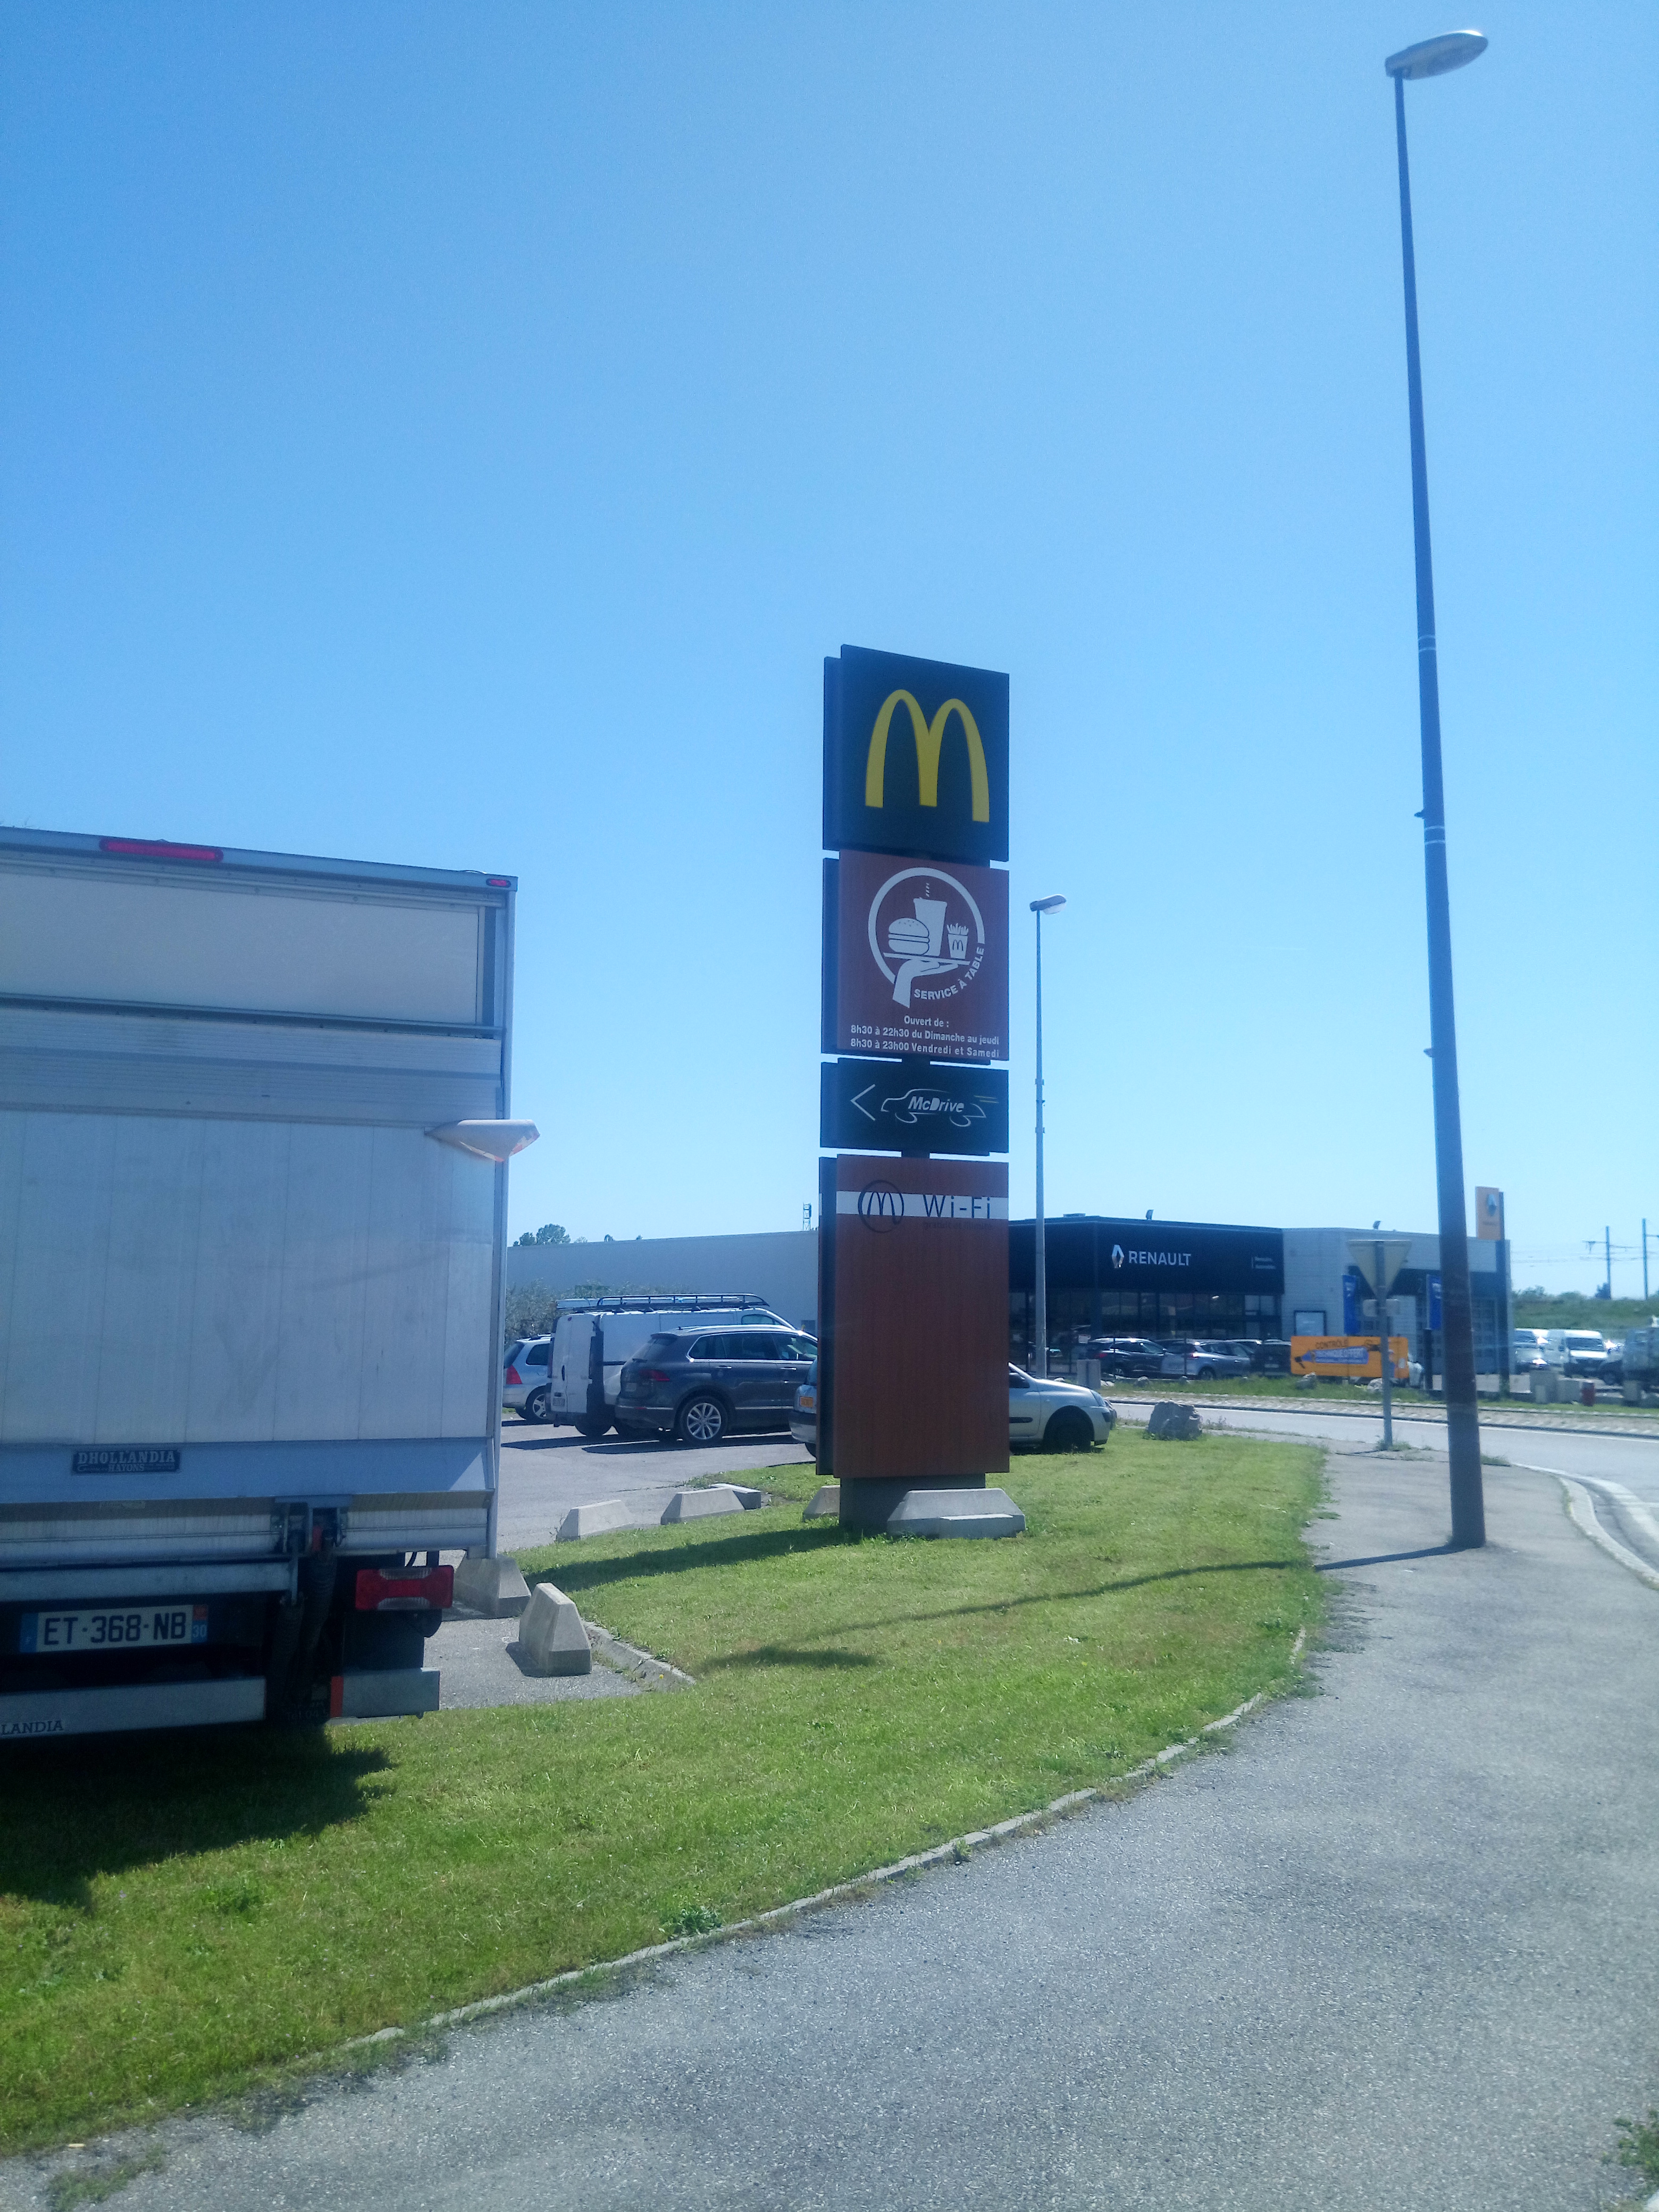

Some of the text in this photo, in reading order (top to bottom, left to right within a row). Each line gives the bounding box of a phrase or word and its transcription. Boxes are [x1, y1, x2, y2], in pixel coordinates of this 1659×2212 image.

[914, 946, 985, 1000] SERVICE À TABLE
[904, 1015, 932, 1026] Ouvert
[934, 1018, 944, 1027] de
[851, 1025, 873, 1034] 8h30
[875, 1026, 881, 1035] à
[883, 1027, 909, 1037] 22h30
[912, 1029, 923, 1038] du
[925, 1030, 965, 1042] Dimanche
[979, 1035, 999, 1045] jeudi
[850, 1038, 999, 1058] 8h30 à 23h00 Vendredi et Samedi
[908, 1096, 965, 1113] McDrive
[923, 1194, 991, 1219] Wi-Fi
[1128, 1250, 1192, 1266] RENAULT
[78, 1450, 175, 1464] DHOLLANDIA
[192, 1624, 206, 1638] 30
[1, 1720, 63, 1735] LANDIA
